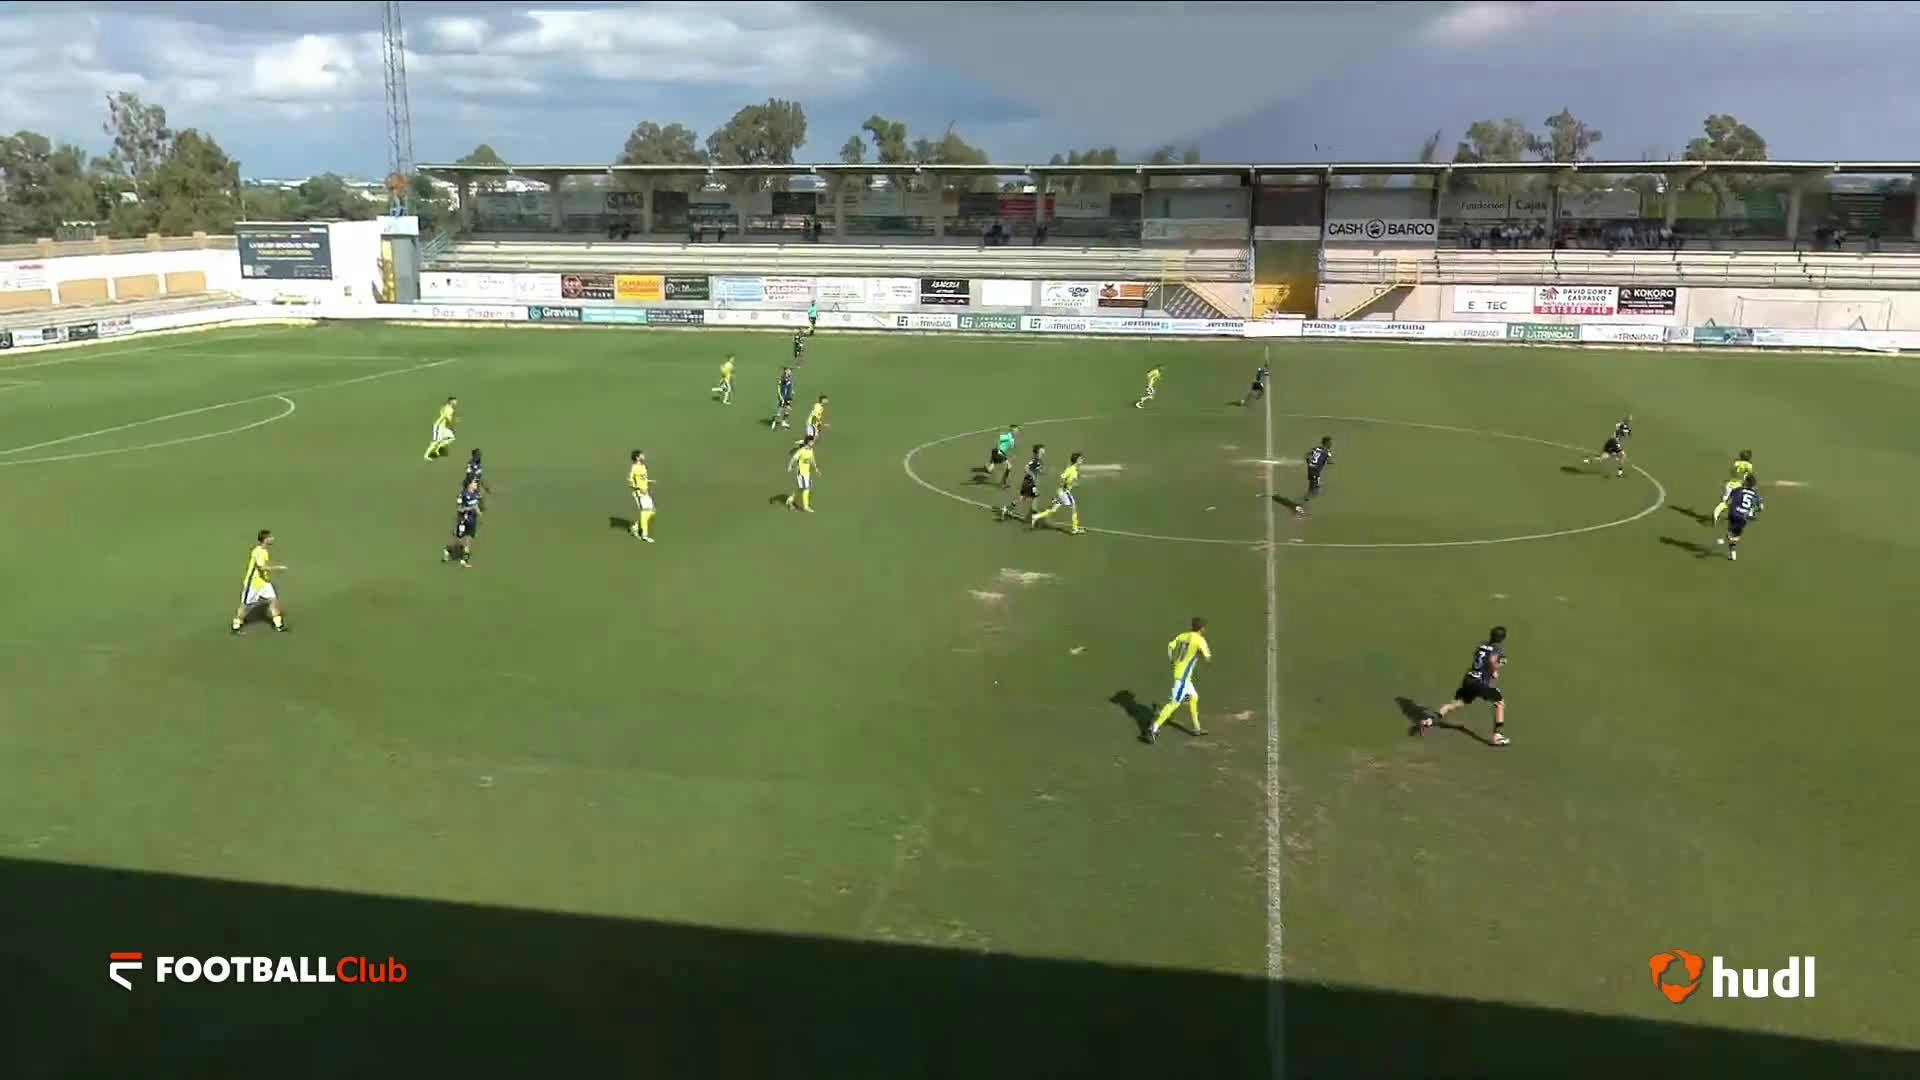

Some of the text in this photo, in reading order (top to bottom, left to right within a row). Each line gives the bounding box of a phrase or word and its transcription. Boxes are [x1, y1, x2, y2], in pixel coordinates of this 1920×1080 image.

[1328, 223, 1435, 236] CASH BARCO
[1633, 288, 1674, 298] KOKORO
[542, 307, 578, 318] Gravina
